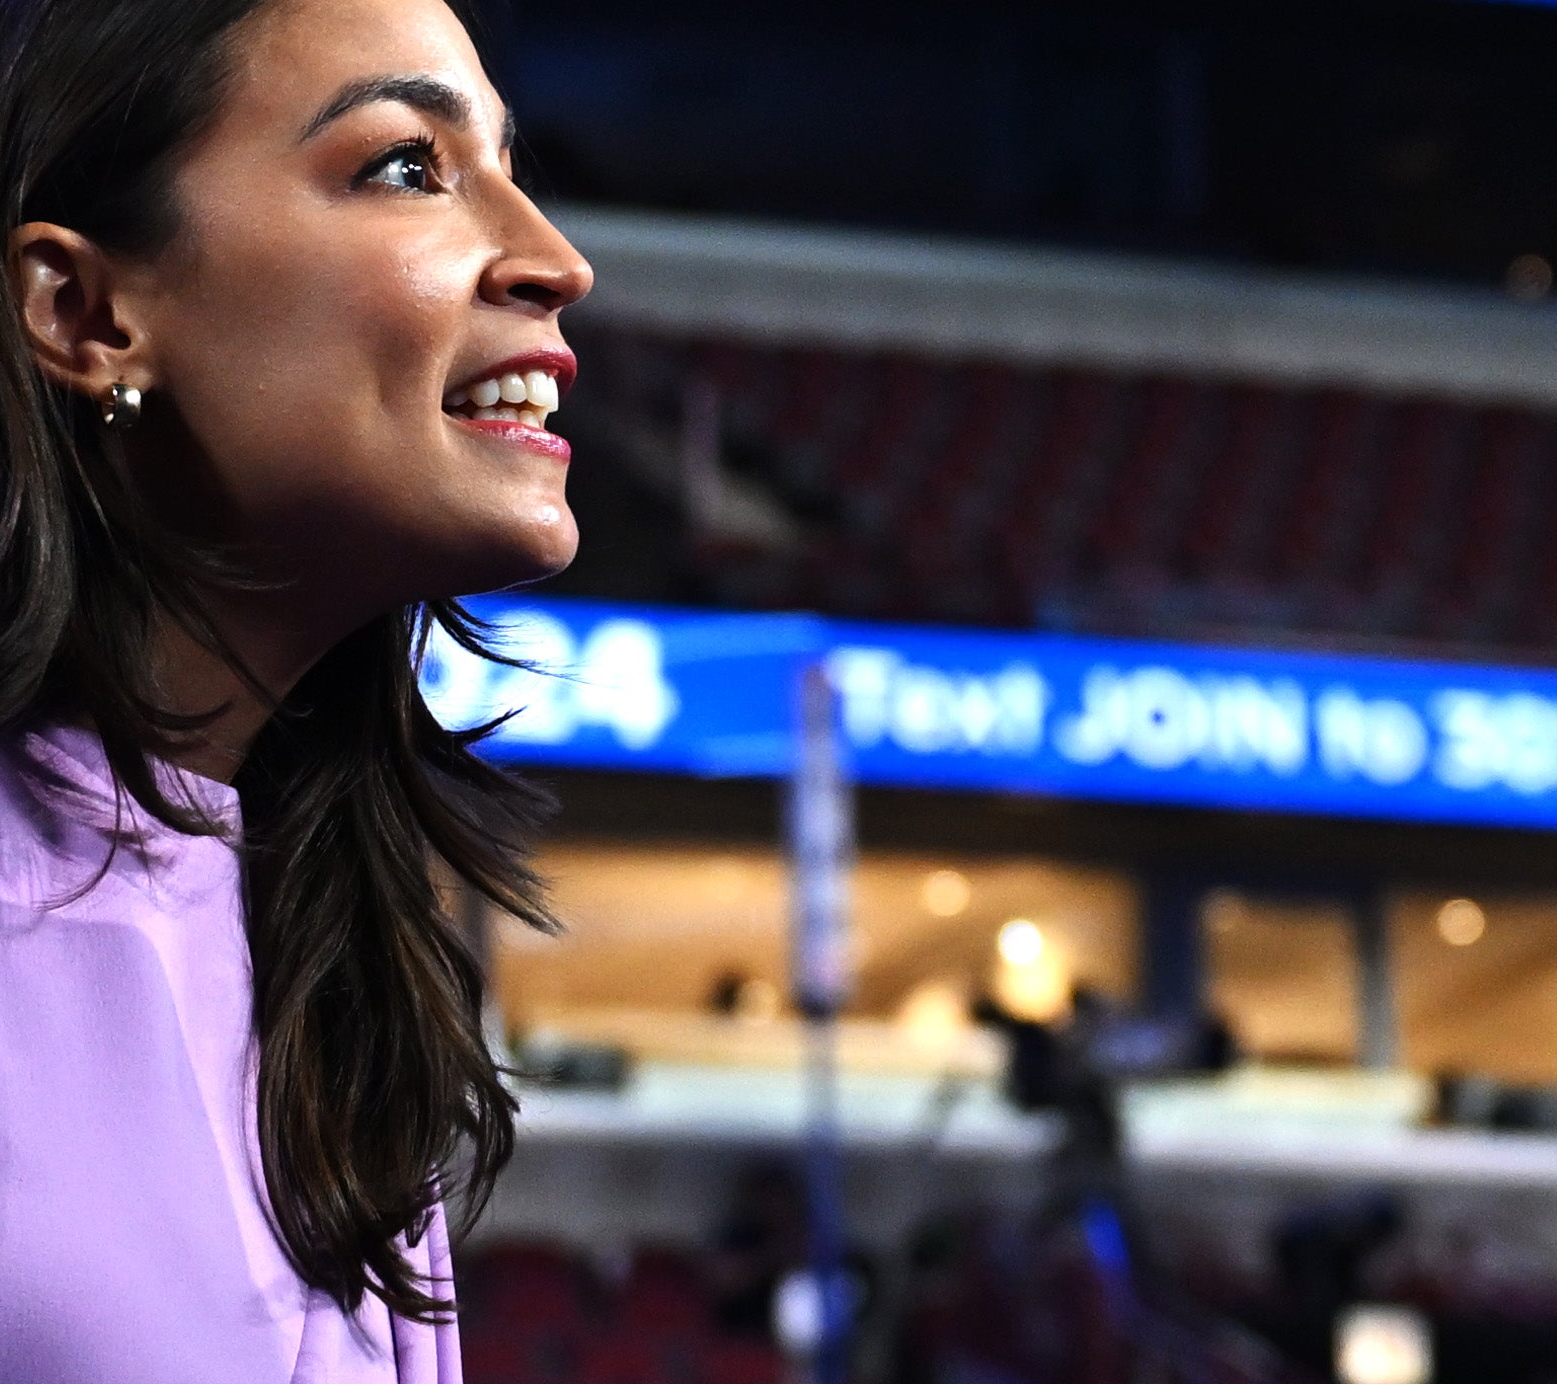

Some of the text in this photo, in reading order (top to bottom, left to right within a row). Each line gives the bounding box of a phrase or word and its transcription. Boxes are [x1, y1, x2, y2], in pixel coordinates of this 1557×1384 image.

[825, 646, 1047, 754] Text
[1055, 668, 1309, 770] JOIN
[1315, 686, 1429, 784] to
